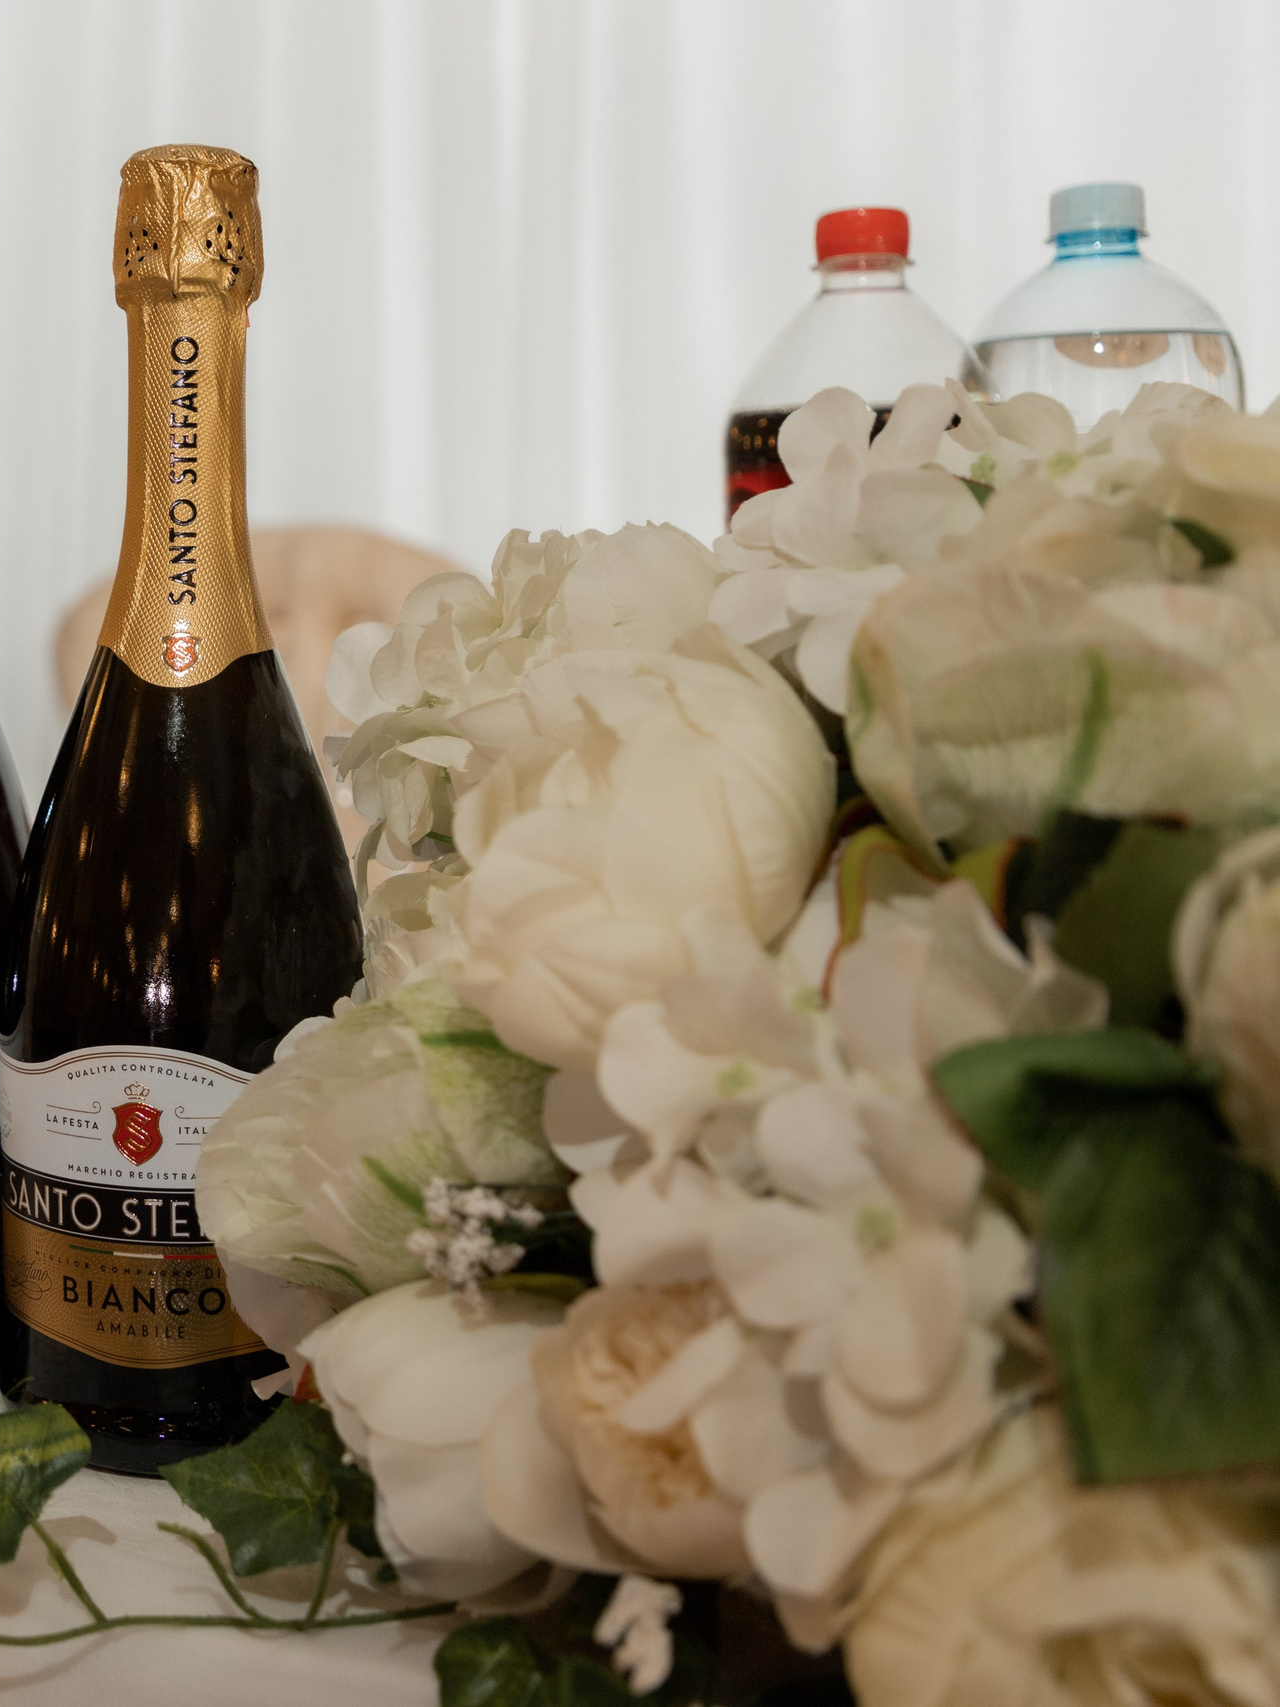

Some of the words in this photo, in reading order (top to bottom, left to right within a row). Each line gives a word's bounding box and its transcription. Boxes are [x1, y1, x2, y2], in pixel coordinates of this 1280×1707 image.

[169, 335, 200, 485] STEFANO
[168, 498, 197, 606] SANTO
[67, 1064, 116, 1081] QUALITA
[121, 1064, 215, 1088] CONTROLLATA
[46, 1113, 59, 1124] LA
[62, 1117, 99, 1130] FESTA
[67, 1163, 123, 1178] MARCHIO
[129, 1171, 197, 1181] REGISTRA
[9, 1170, 102, 1231] SANTO
[121, 1197, 207, 1238] STE
[35, 1250, 90, 1269] MIGLIOR
[100, 1264, 193, 1278] COMPAGNO
[62, 1274, 226, 1316] BIANCO
[96, 1320, 186, 1340] AMABILE
